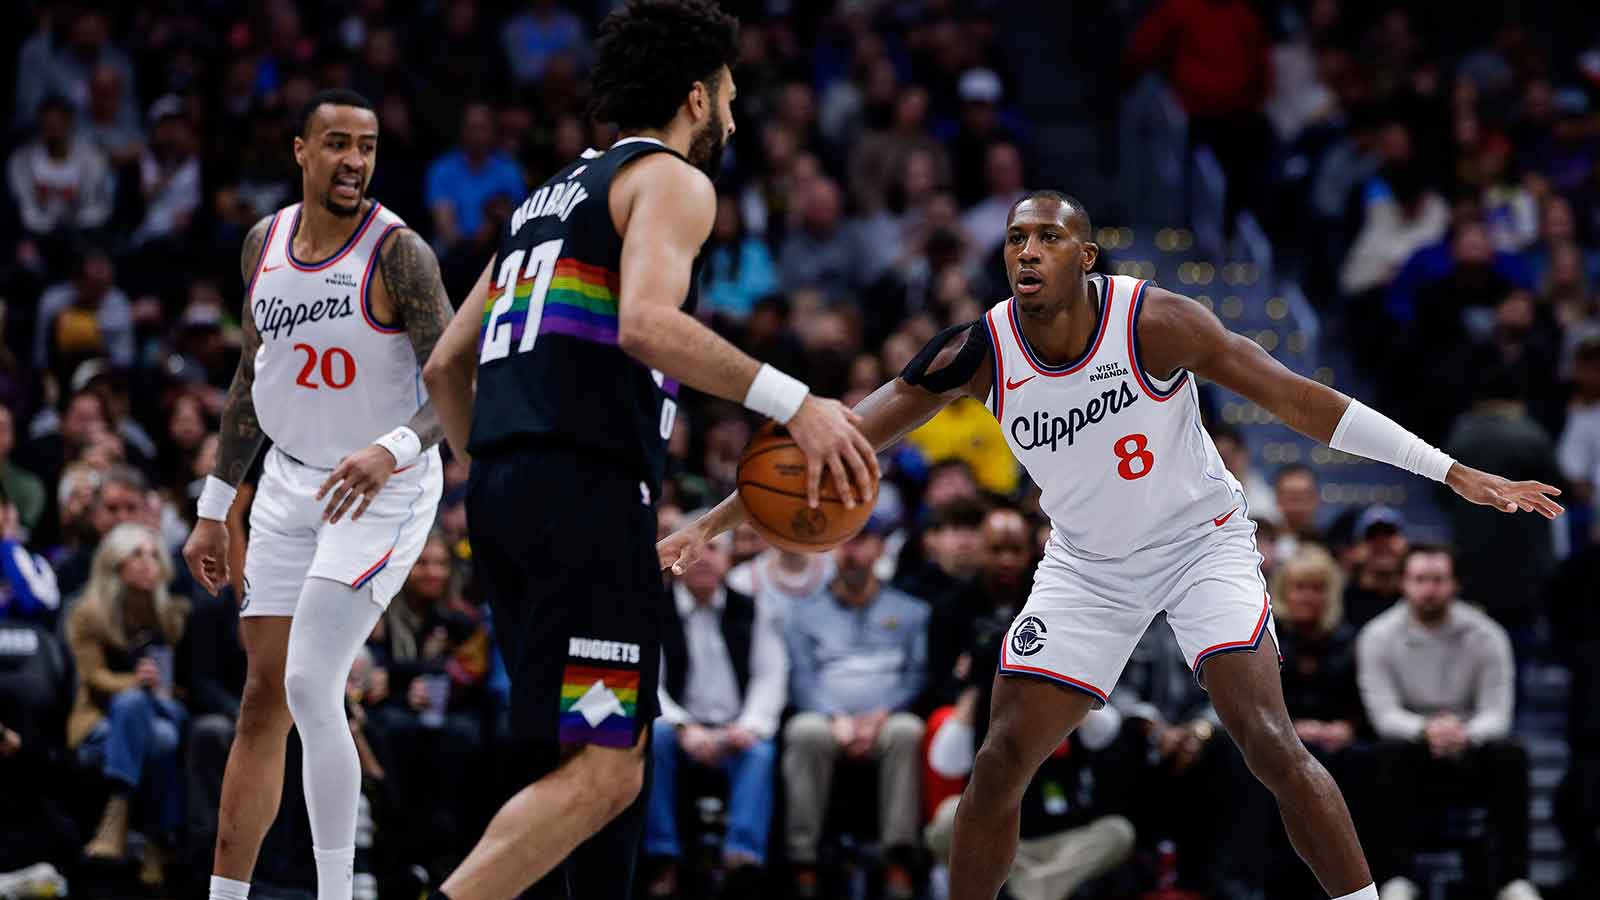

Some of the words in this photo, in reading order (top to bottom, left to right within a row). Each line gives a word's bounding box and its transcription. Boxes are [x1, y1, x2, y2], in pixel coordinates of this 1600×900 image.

[254, 295, 353, 340] Clippers
[480, 239, 564, 364] 27
[293, 342, 357, 390] 20
[1089, 367, 1129, 382] RWANDA
[1096, 361, 1119, 373] VISIT
[1011, 380, 1139, 452] Clippers
[1113, 433, 1155, 481] 8
[568, 636, 641, 664] NUGGETS
